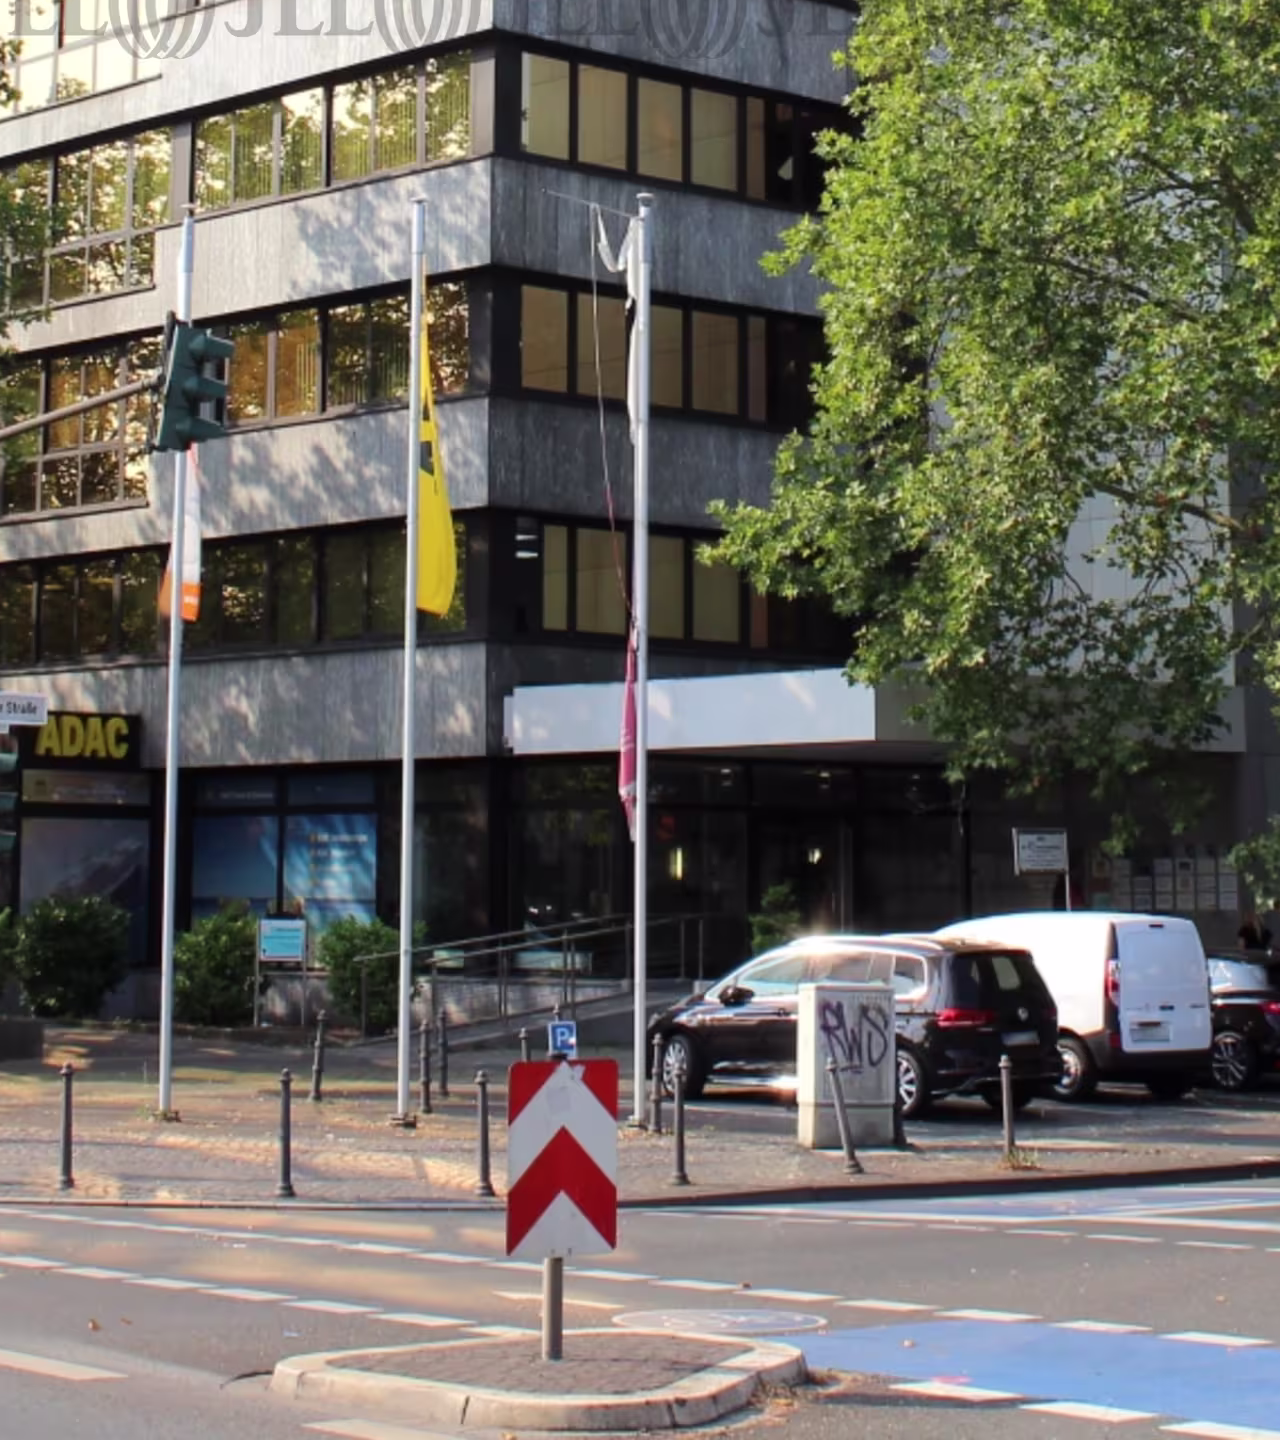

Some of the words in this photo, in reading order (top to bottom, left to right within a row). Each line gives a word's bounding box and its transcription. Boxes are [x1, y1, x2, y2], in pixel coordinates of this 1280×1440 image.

[6, 701, 38, 714] Straße
[35, 714, 129, 759] ADAC
[556, 1027, 570, 1047] P
